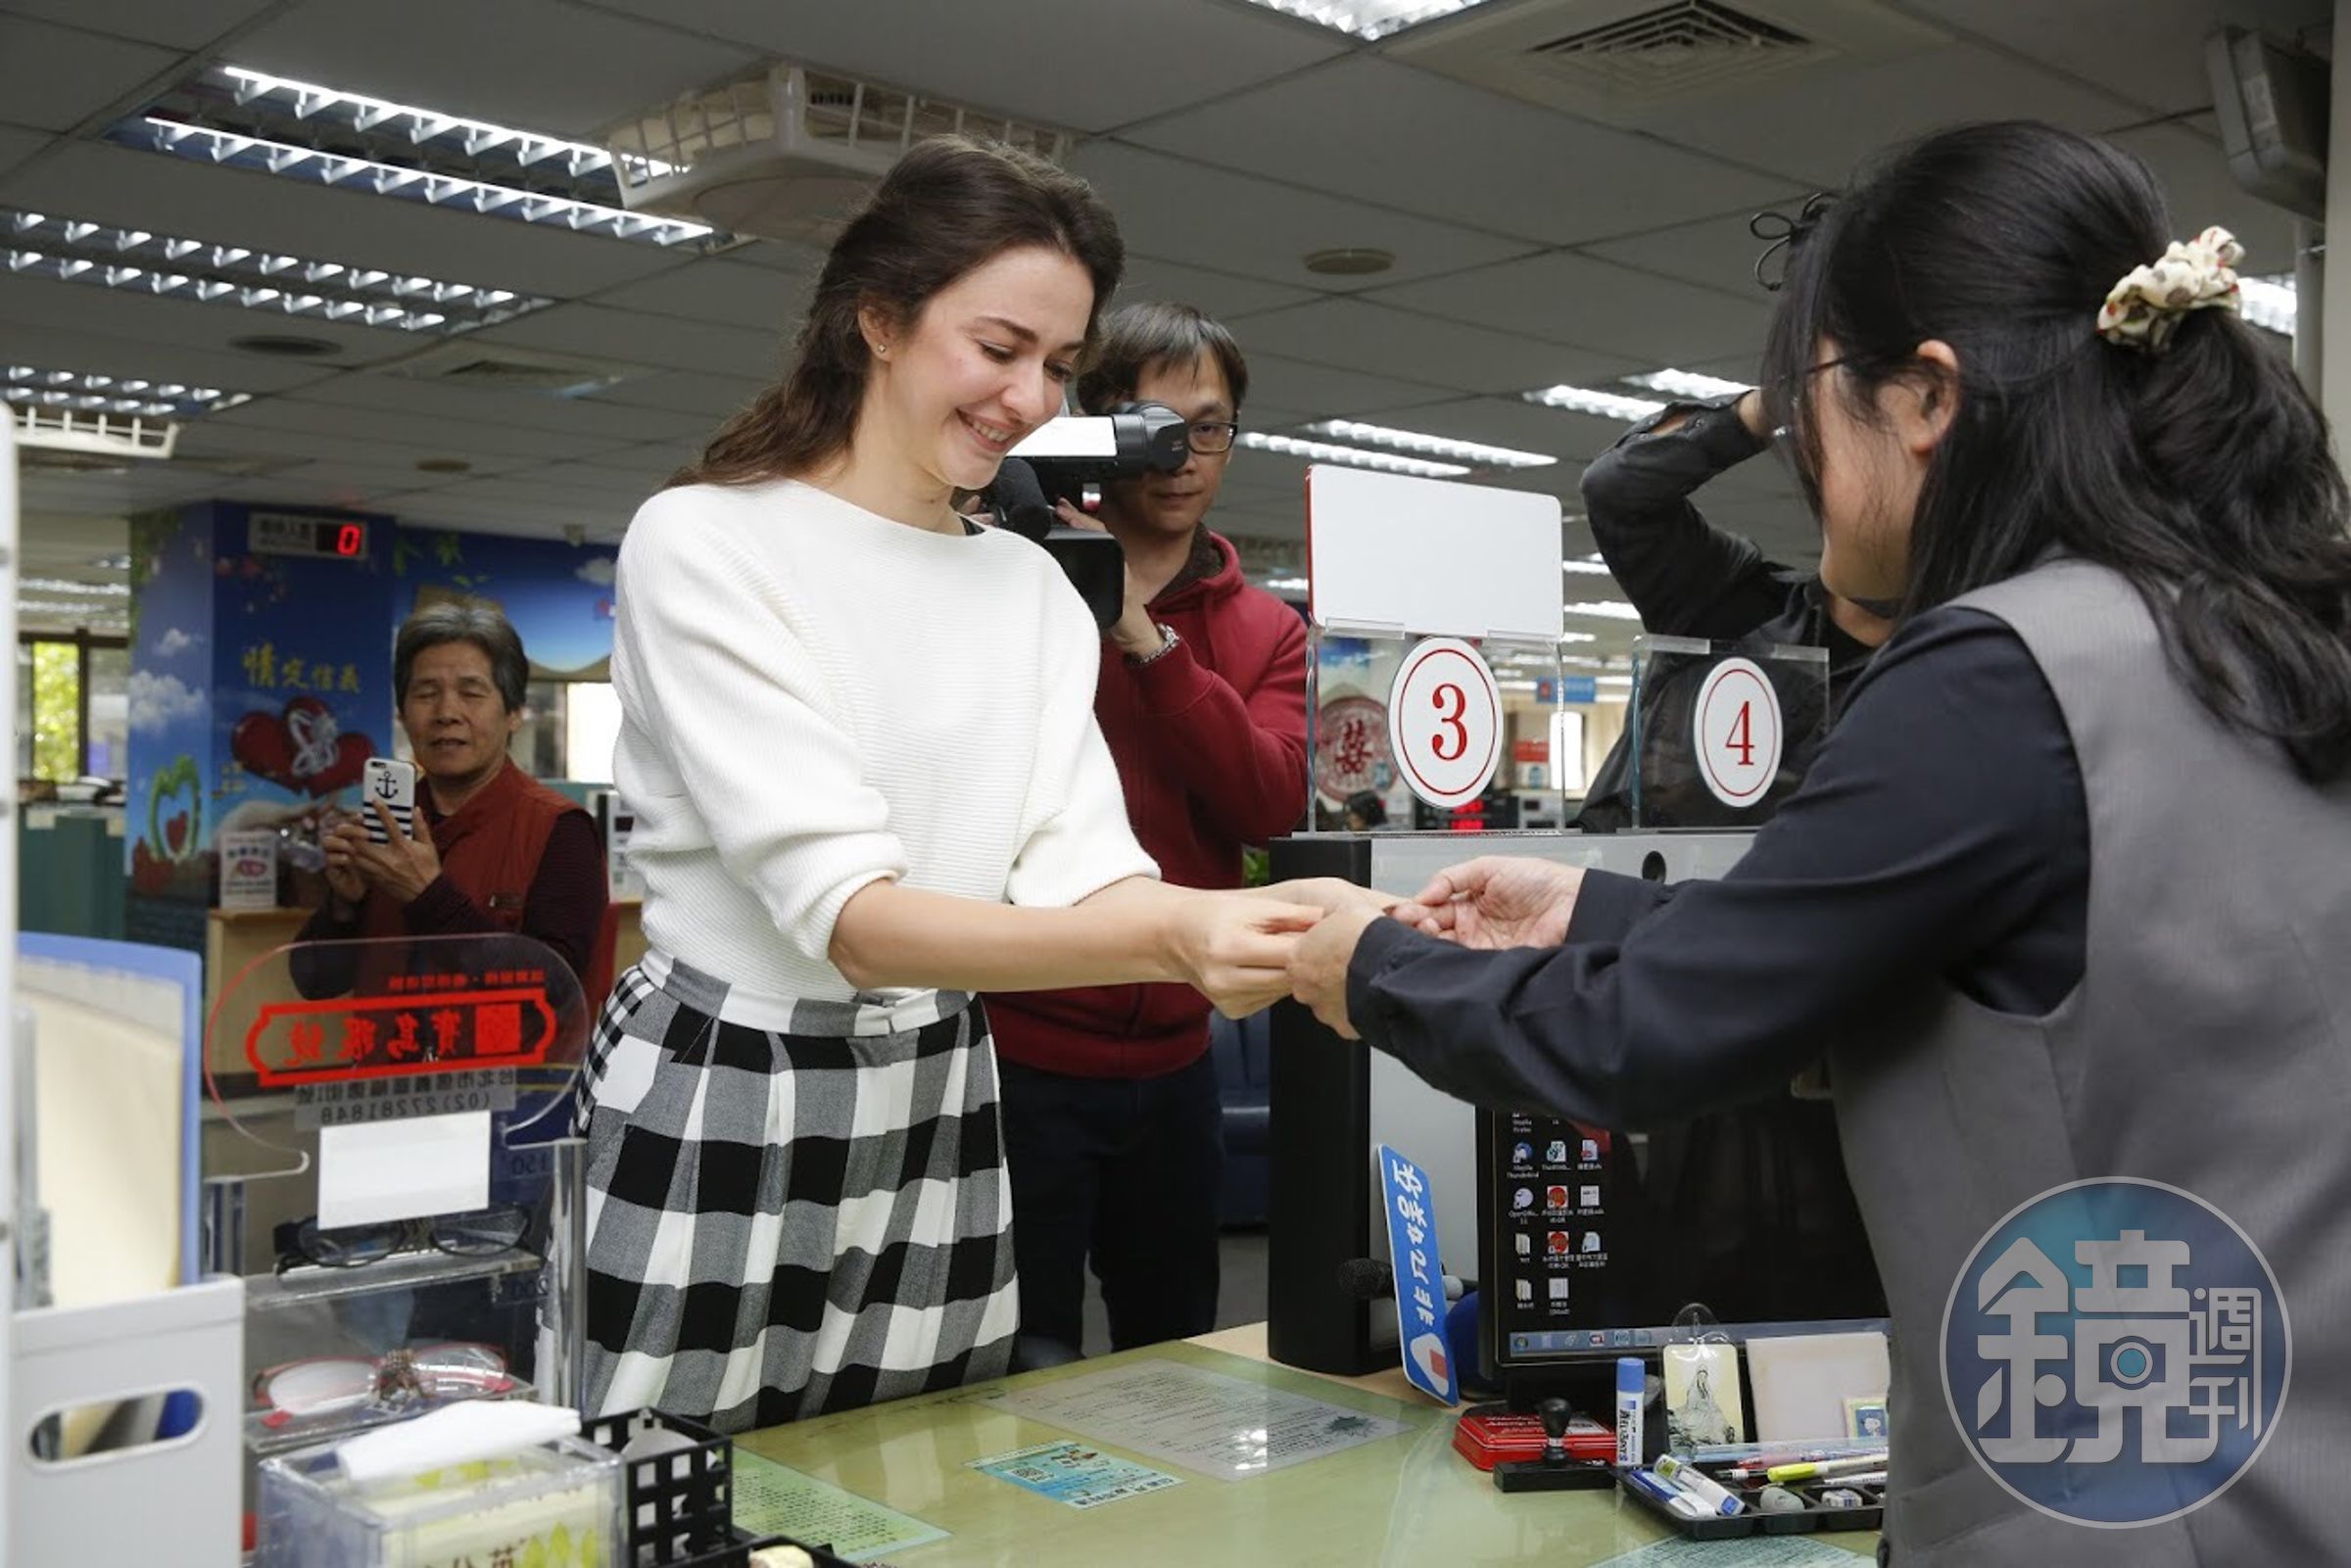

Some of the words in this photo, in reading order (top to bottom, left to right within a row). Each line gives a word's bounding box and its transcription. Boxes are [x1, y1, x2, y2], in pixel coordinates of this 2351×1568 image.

[337, 523, 361, 556] 0
[1431, 683, 1468, 761] 3
[1725, 701, 1755, 766] 4
